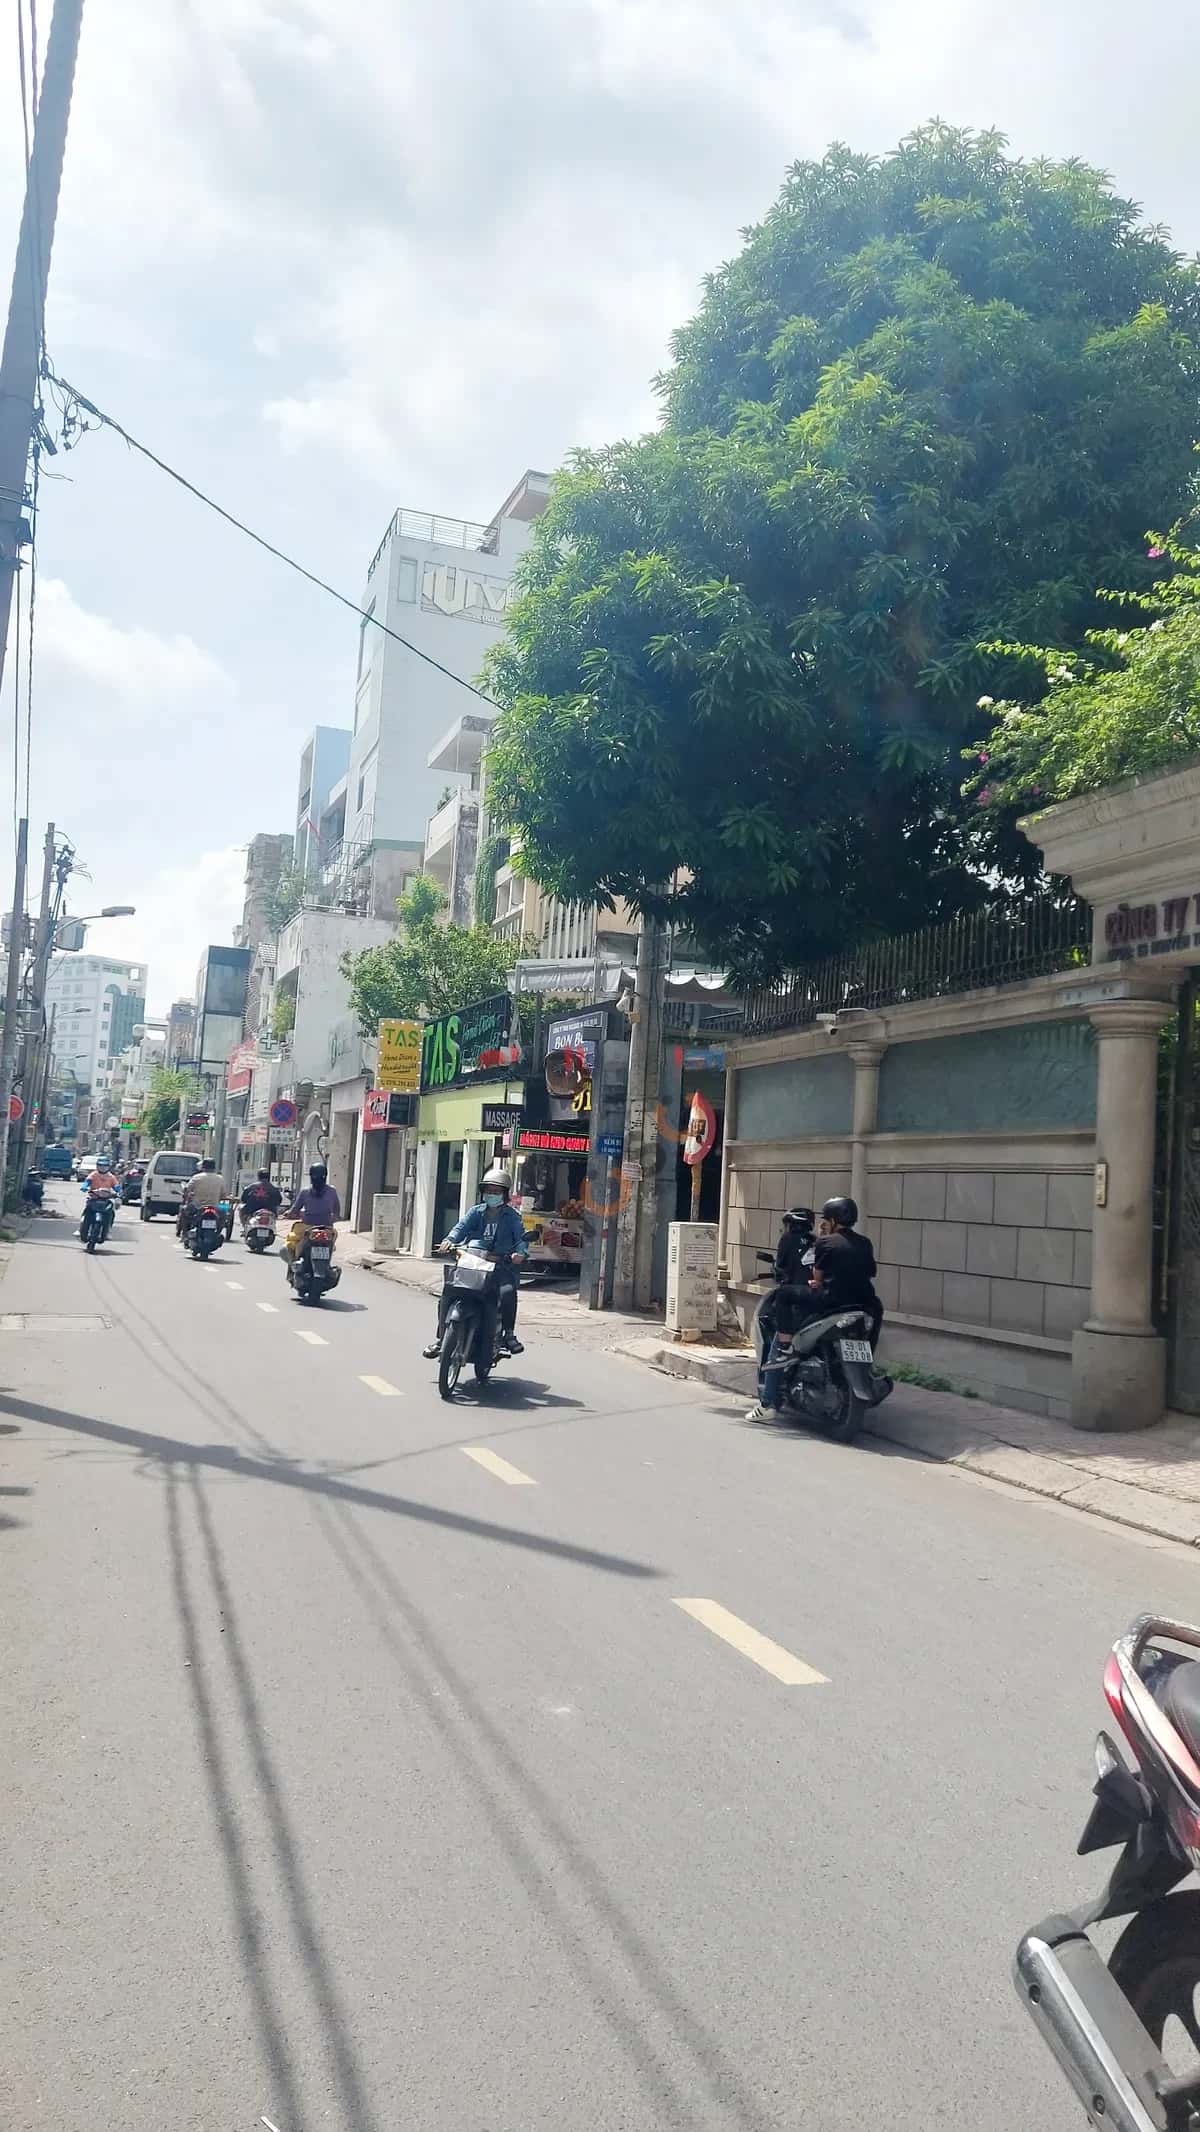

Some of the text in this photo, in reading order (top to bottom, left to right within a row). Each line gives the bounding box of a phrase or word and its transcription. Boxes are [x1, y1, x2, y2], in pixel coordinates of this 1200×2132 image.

[1161, 897, 1190, 935] TY
[384, 1028, 419, 1048] TAS
[424, 1015, 463, 1086] TAS
[484, 1111, 521, 1127] MASSAGE
